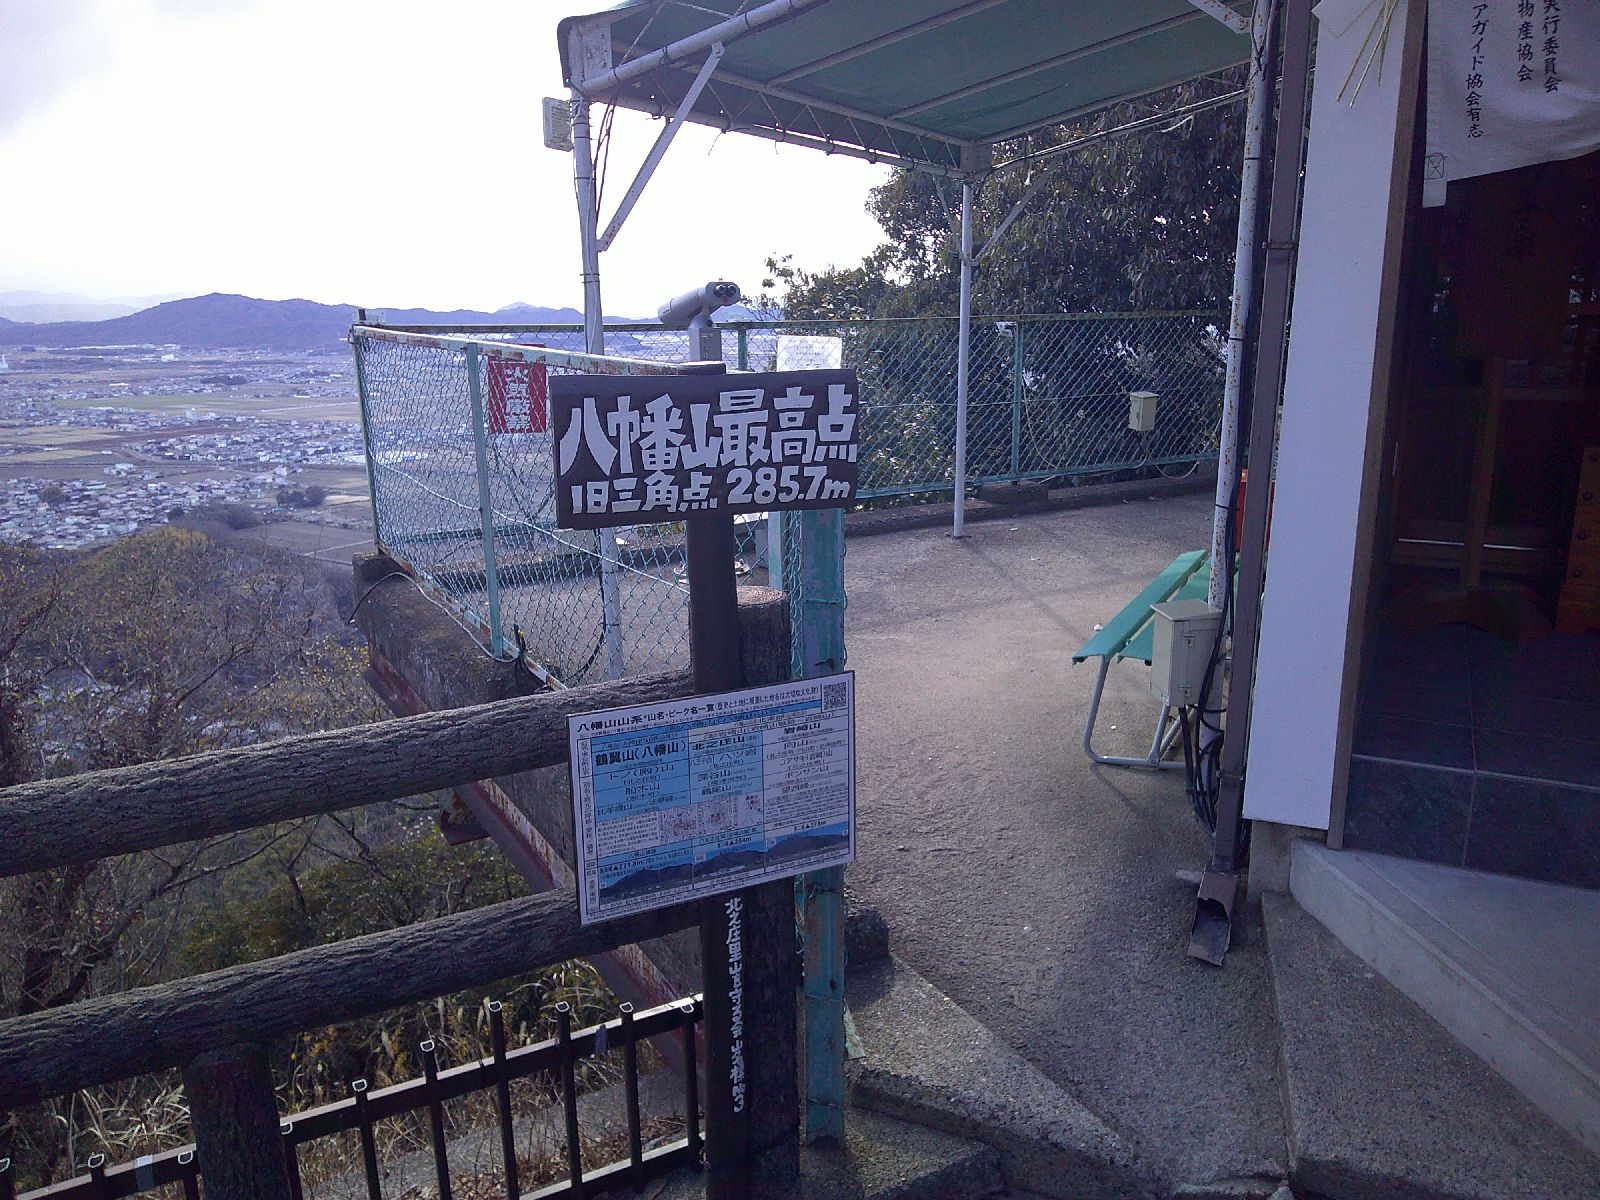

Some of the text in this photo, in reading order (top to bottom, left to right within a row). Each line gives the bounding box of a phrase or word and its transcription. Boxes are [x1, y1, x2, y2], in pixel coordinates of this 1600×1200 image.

[1465, 3, 1489, 139] アガイド協会有志
[1517, 0, 1535, 82] 物産協会
[560, 384, 857, 477] 八幡山最高点
[571, 465, 850, 514] 旧三角点 285.7m
